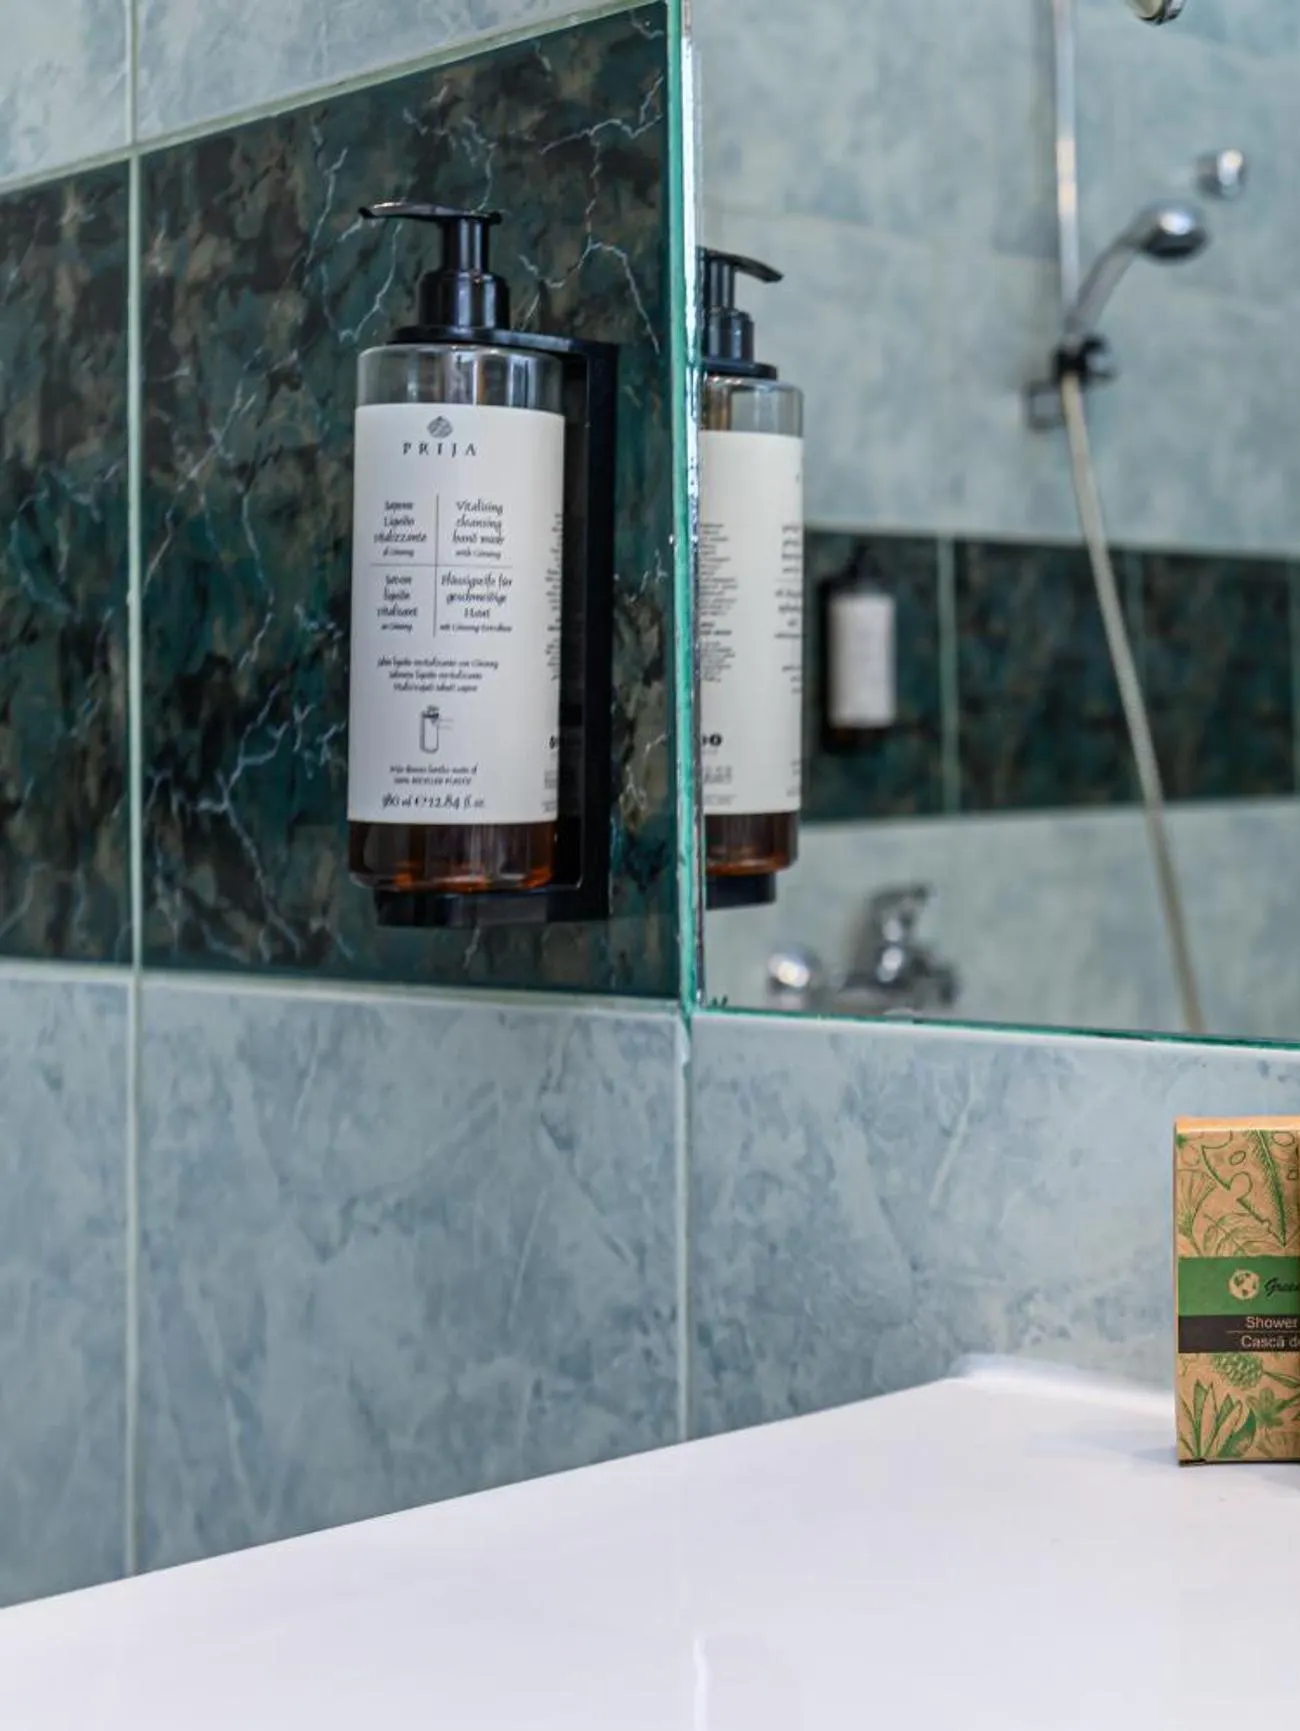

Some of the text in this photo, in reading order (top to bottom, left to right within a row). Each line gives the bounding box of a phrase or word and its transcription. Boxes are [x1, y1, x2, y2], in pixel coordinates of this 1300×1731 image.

[402, 441, 477, 458] PRIJA
[455, 499, 504, 515] Vitalising
[1245, 1315, 1298, 1329] Shower
